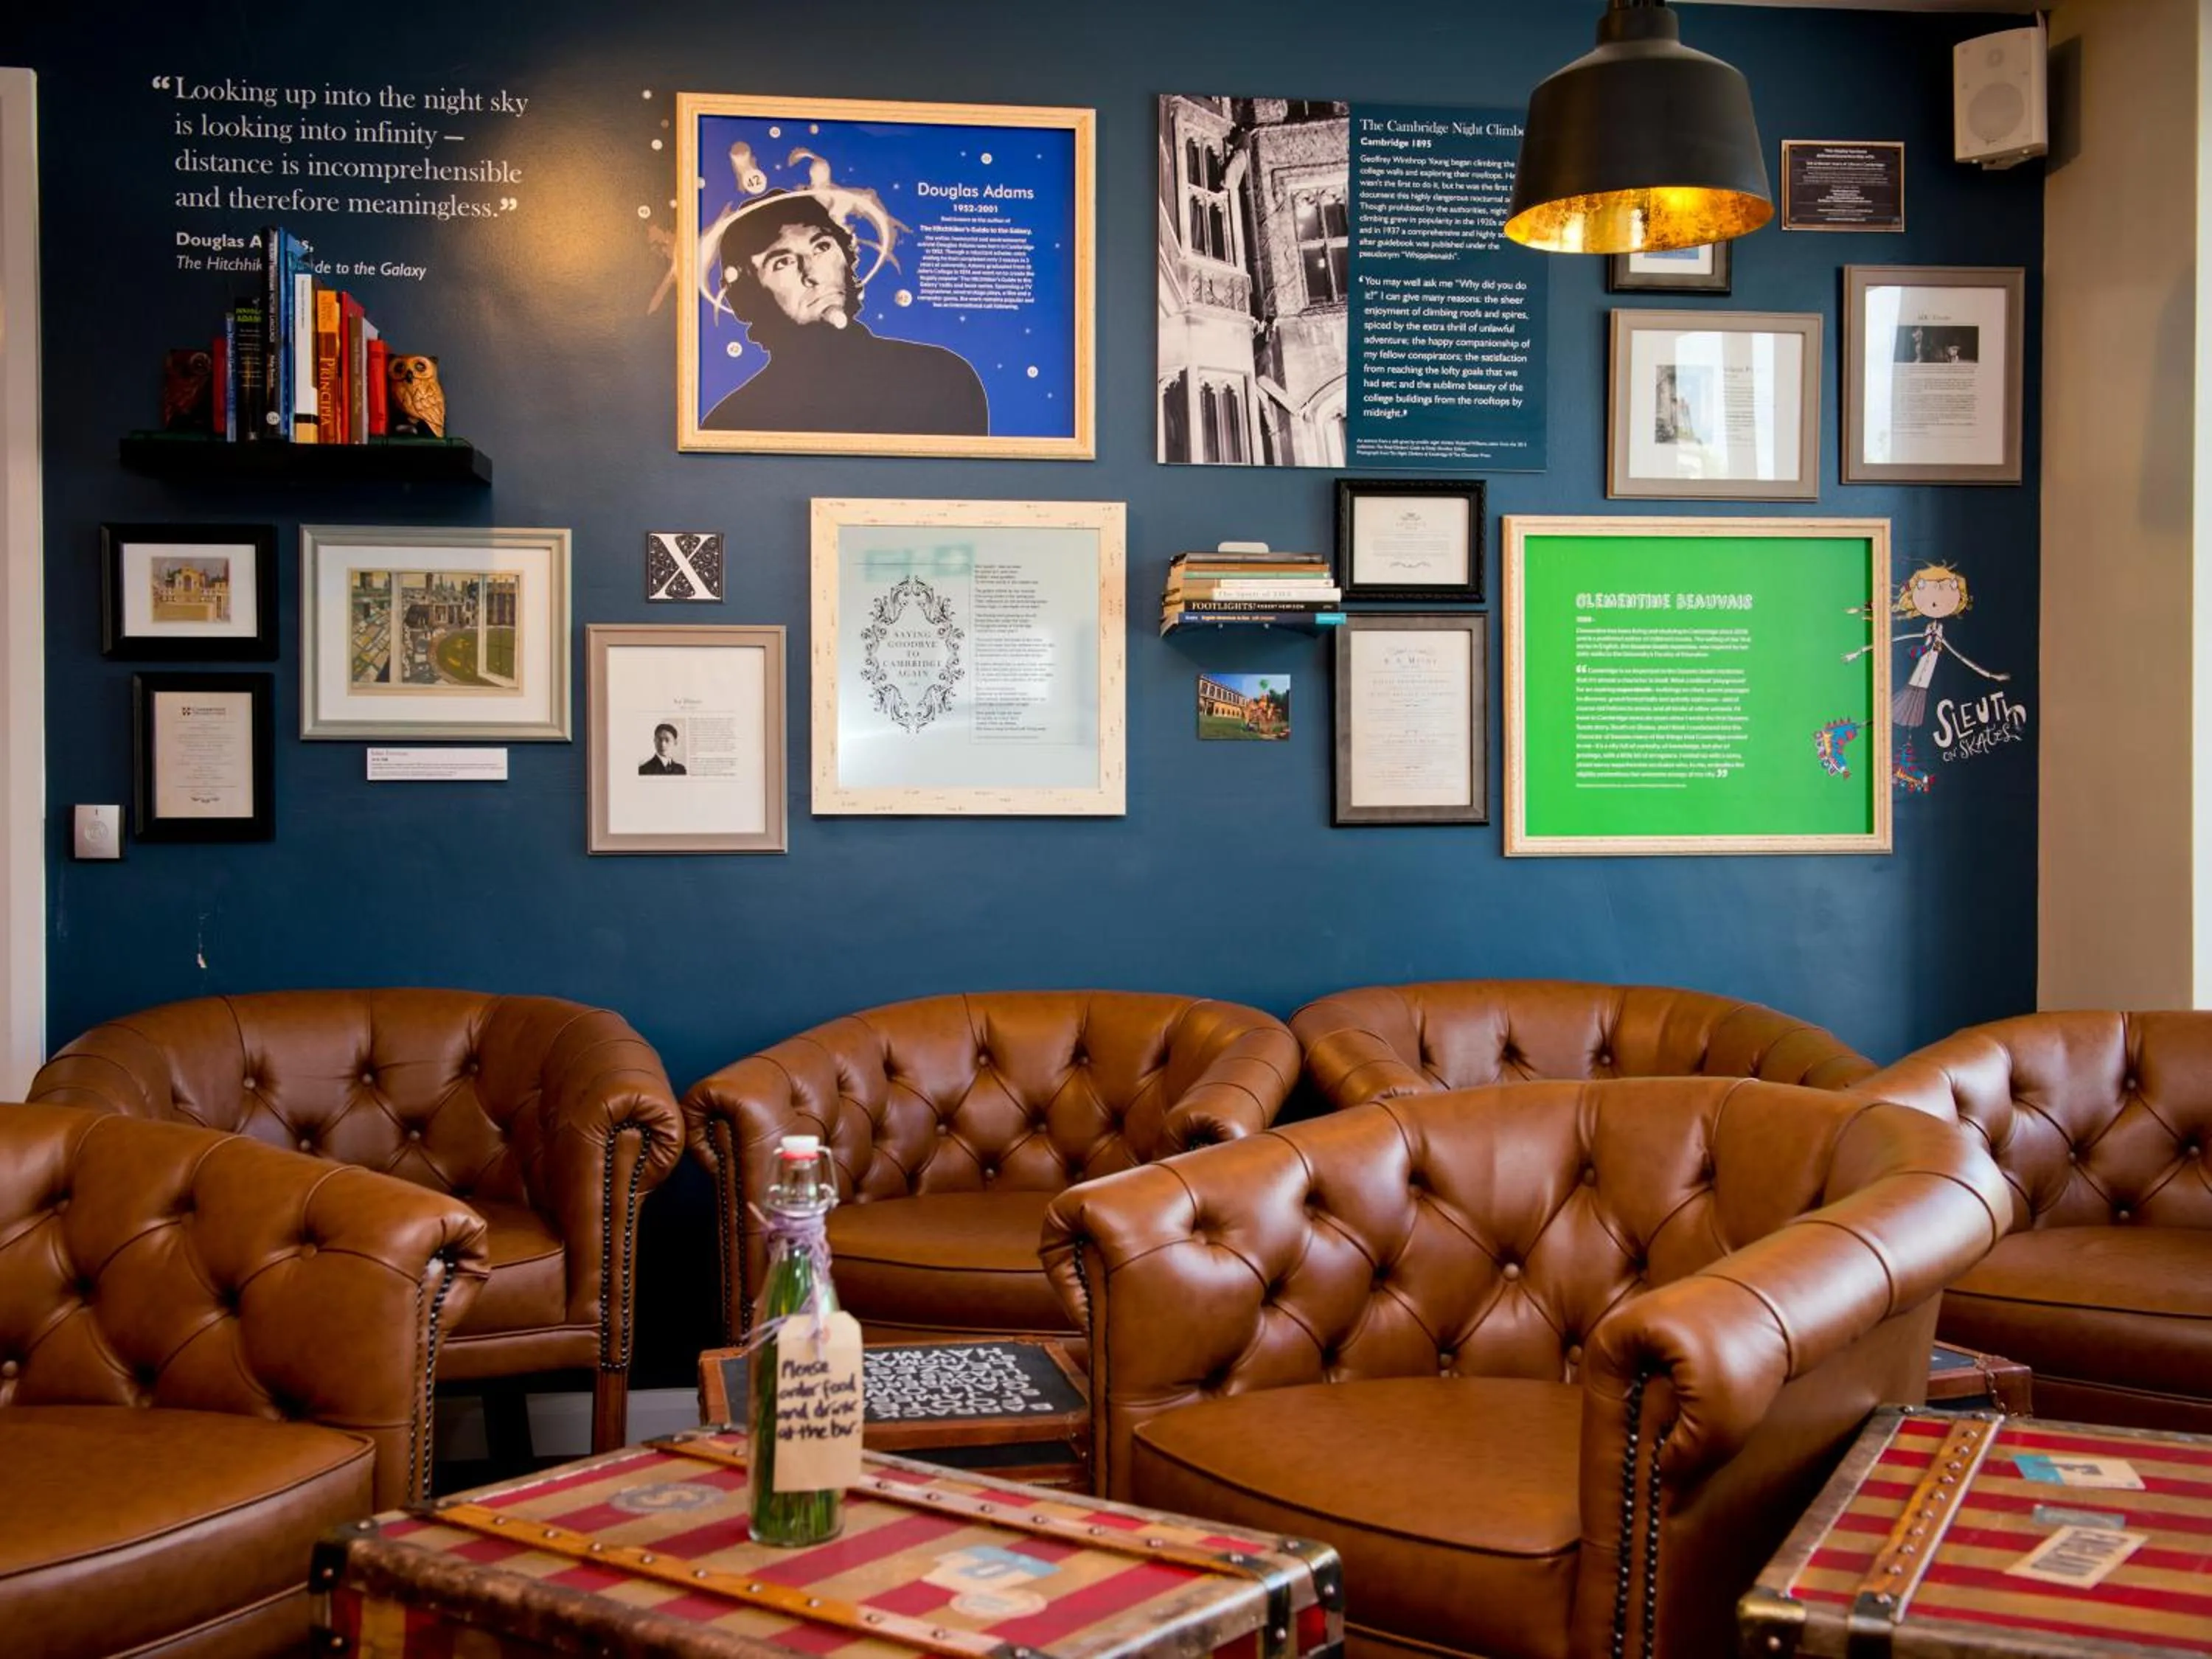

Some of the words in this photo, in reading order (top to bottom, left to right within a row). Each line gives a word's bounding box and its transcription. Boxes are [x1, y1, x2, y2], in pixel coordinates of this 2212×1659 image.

[285, 88, 316, 109] up
[324, 82, 371, 106] into
[379, 84, 415, 108] the
[424, 87, 484, 115] night
[490, 89, 529, 116] sky
[175, 113, 192, 135] is
[201, 114, 293, 144] looking
[300, 117, 347, 141] into
[355, 119, 437, 150] infinity
[1360, 119, 1382, 131] The
[1387, 120, 1448, 135] Cambridge
[1453, 122, 1482, 136] Night
[1360, 137, 1408, 149] Cambridge
[1412, 139, 1431, 147] 1895
[175, 148, 273, 174] distance
[282, 152, 299, 175] is
[308, 153, 524, 183] incomprehensible
[747, 174, 762, 187] 42
[175, 186, 220, 208] and
[229, 187, 339, 212] therefore
[918, 182, 978, 200] Douglas
[983, 184, 1034, 199] Adams
[953, 204, 998, 213] 1952-2001
[177, 232, 245, 251] Douglas
[177, 255, 201, 270] The
[207, 257, 262, 272] Hitchhik
[336, 263, 349, 274] to
[354, 261, 375, 275] the
[380, 262, 427, 281] Galaxy
[1382, 279, 1401, 288] may
[1403, 278, 1421, 286] well
[1423, 279, 1436, 287] ask
[1481, 280, 1495, 289] did
[1497, 282, 1513, 291] you
[1514, 281, 1526, 290] do
[1402, 293, 1419, 302] give
[1422, 295, 1444, 304] many
[1484, 294, 1498, 304] the
[1500, 295, 1523, 304] sheer
[1364, 307, 1409, 316] enjoyment
[1411, 307, 1421, 316] of
[1422, 307, 1458, 319] climbing
[1460, 308, 1482, 317] roofs
[1484, 310, 1500, 318] and
[1502, 311, 1528, 320] spires,
[1364, 321, 1391, 330] spiced
[1394, 321, 1404, 332] by
[1406, 321, 1420, 330] the
[1447, 322, 1467, 331] thrill
[1468, 323, 1477, 332] of
[1479, 324, 1514, 333] unlawful
[1412, 336, 1426, 345] the
[1428, 336, 1453, 348] happy
[1455, 339, 1519, 349] companionship
[1520, 339, 1530, 348] of
[1364, 352, 1377, 360] my
[1380, 349, 1405, 358] fellow
[1465, 352, 1479, 361] the
[1481, 353, 1527, 362] satisfaction
[1363, 364, 1385, 373] from
[1387, 365, 1423, 376] reaching
[1425, 366, 1439, 375] the
[1441, 366, 1460, 377] lofty
[1461, 366, 1484, 378] goals
[1485, 367, 1503, 376] that
[319, 357, 335, 425] PRINCIPIA
[1363, 379, 1379, 387] had
[1399, 380, 1415, 388] and
[1416, 380, 1430, 389] the
[1433, 380, 1466, 389] sublime
[1467, 381, 1496, 392] beauty
[1498, 381, 1508, 391] of
[1509, 383, 1523, 392] the
[1363, 394, 1394, 404] college
[1396, 394, 1432, 406] buildings
[1434, 394, 1455, 403] from
[1458, 395, 1472, 404] the
[1473, 396, 1510, 407] rooftops
[1512, 397, 1523, 408] by
[649, 534, 720, 599] X
[1576, 594, 1671, 609] CLEMENTINE
[1676, 594, 1753, 610] BEAUVAIS
[1933, 691, 2027, 748] SLEUTH
[782, 1360, 829, 1378] Please
[779, 1382, 816, 1399] order
[823, 1373, 856, 1399] food
[778, 1402, 809, 1419] and
[778, 1426, 794, 1441] at
[799, 1424, 828, 1440] the
